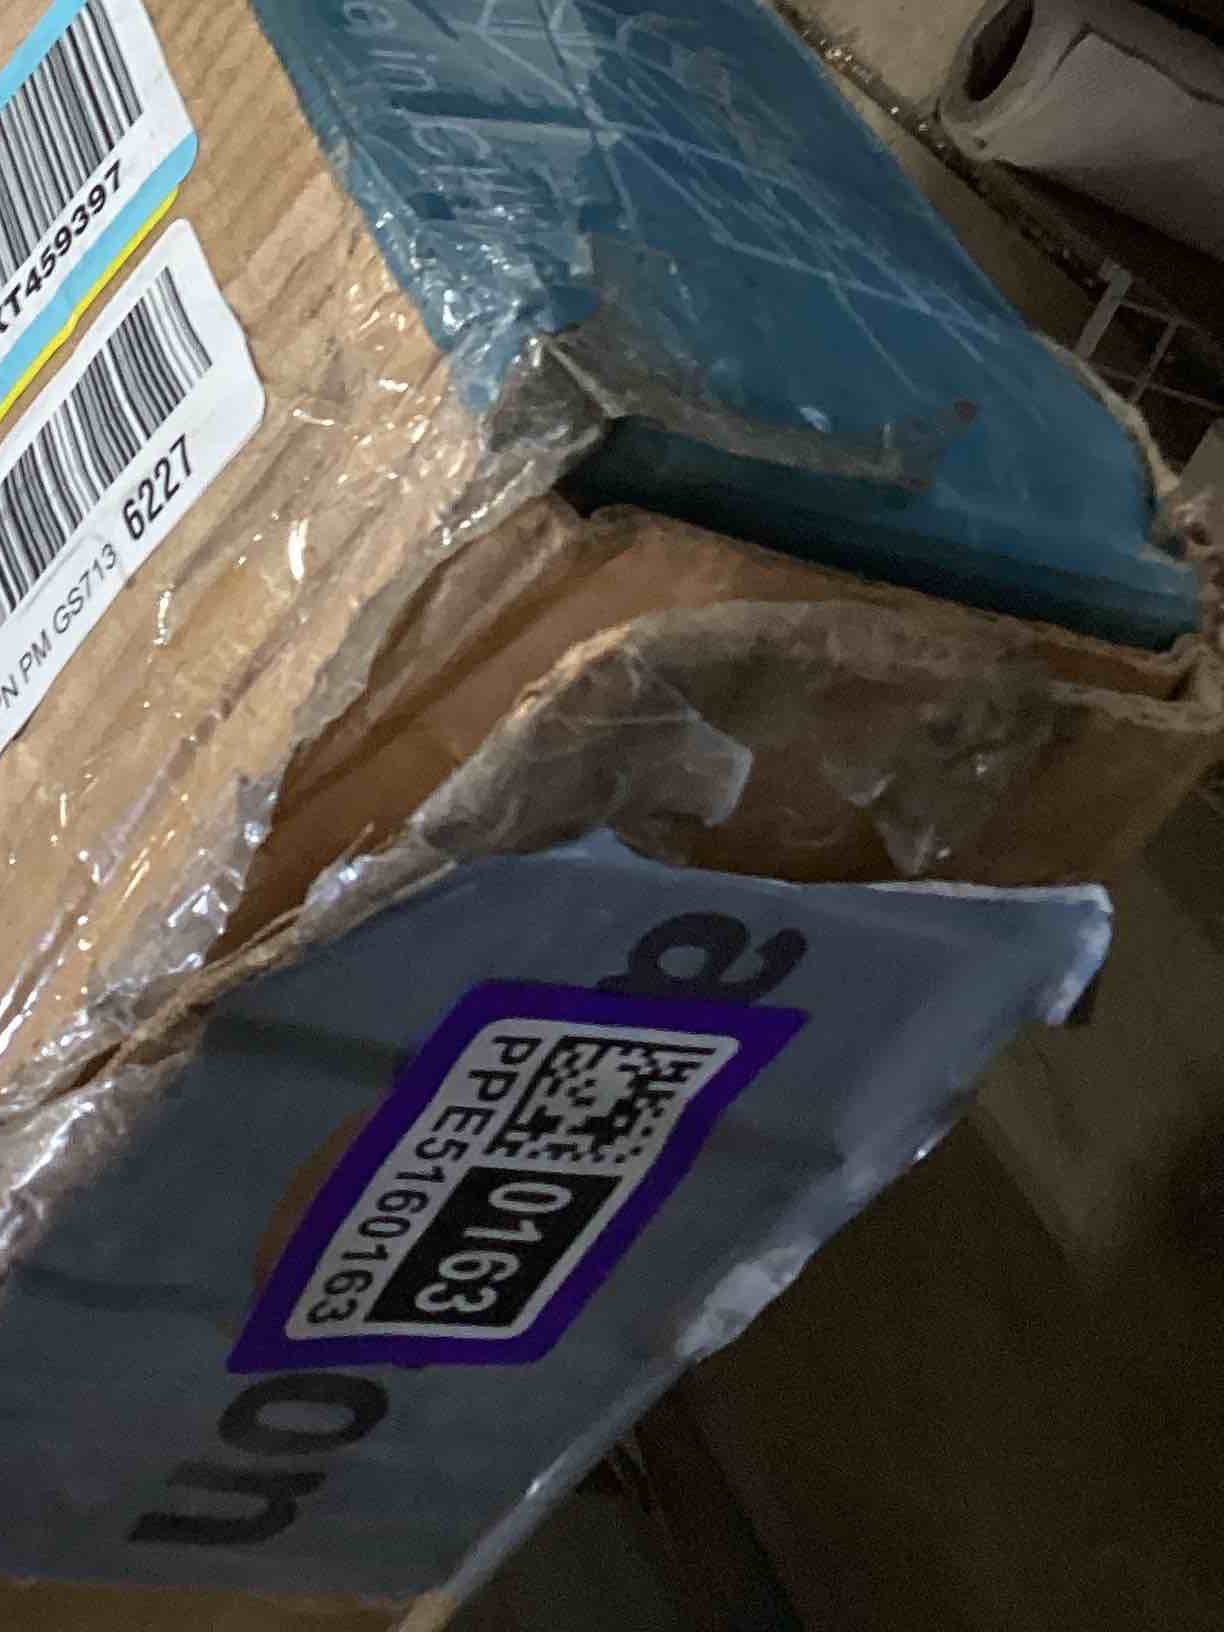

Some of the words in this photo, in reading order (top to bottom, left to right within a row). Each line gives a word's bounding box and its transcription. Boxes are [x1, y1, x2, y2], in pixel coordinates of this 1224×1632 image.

[19, 629, 52, 684] PM
[52, 543, 117, 635] GS713
[123, 433, 193, 542] 6227
[306, 1034, 543, 1325] PPE5160163
[414, 1181, 573, 1313] 0163
